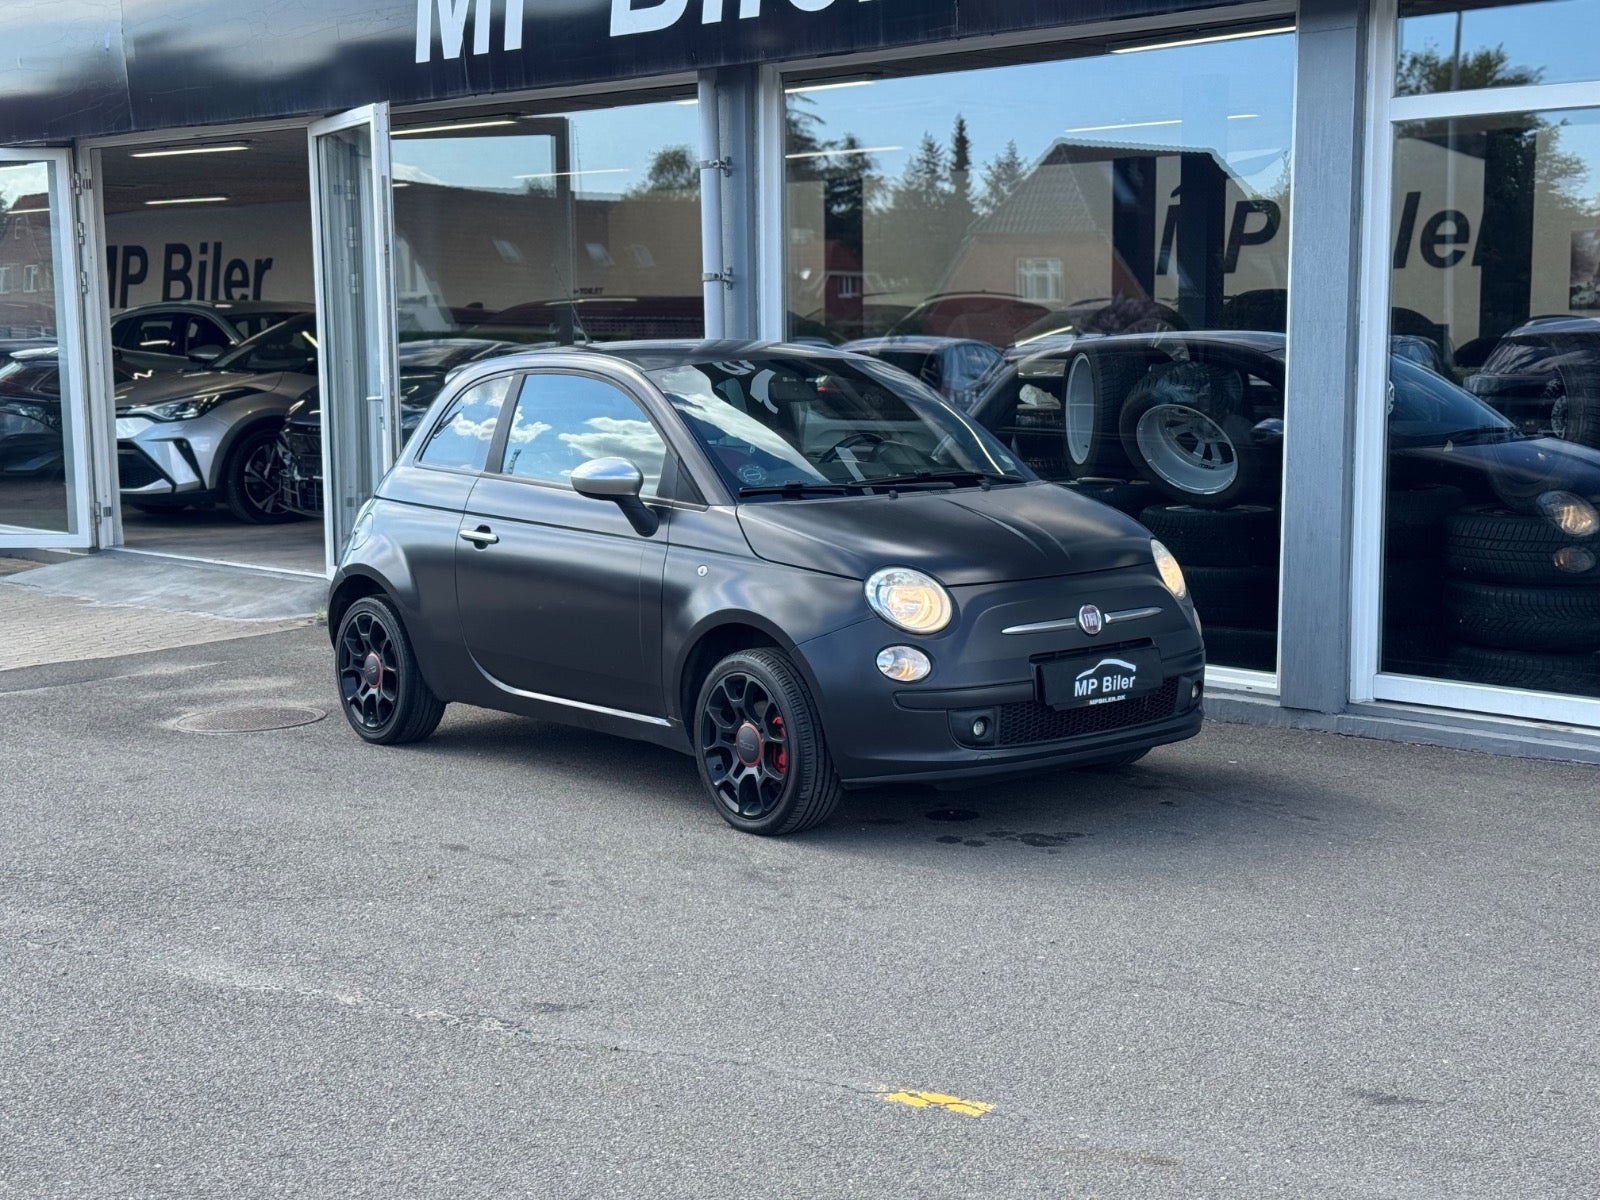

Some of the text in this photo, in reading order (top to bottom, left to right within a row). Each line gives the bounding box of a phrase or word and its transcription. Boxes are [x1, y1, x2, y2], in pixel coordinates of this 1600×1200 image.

[162, 241, 274, 301] Biler
[1074, 675, 1136, 697] MP Biler
[1089, 695, 1126, 705] MPBILER.DK
